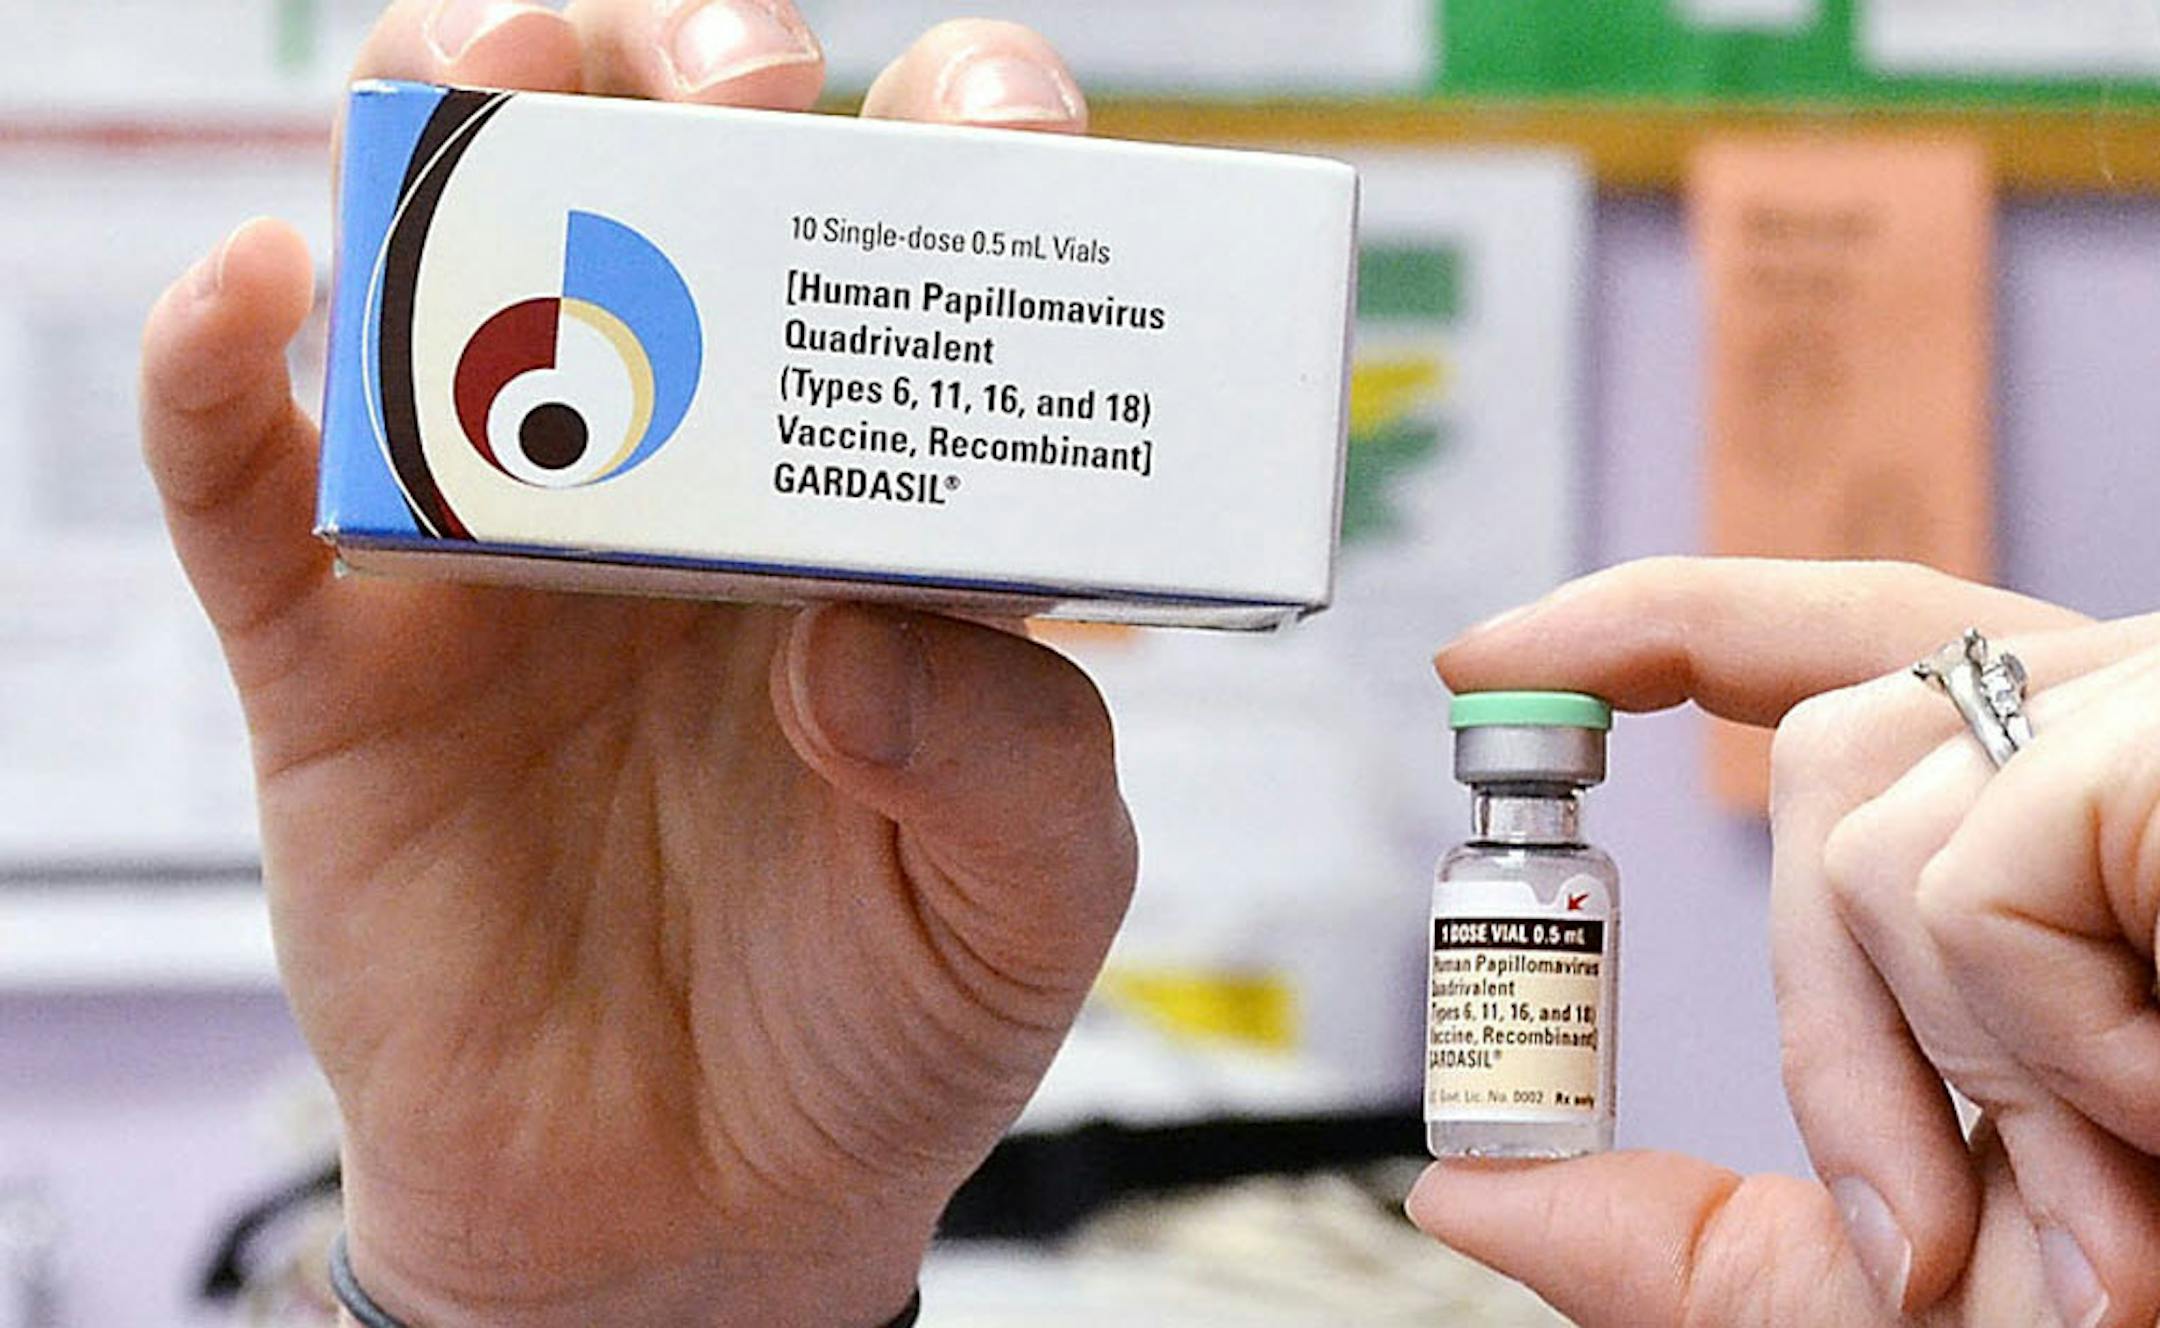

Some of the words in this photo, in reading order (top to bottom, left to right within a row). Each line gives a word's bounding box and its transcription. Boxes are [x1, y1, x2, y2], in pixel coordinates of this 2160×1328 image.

[793, 217, 817, 240] 10
[824, 218, 966, 253] Single-dose
[973, 231, 1006, 257] 0.5
[1012, 240, 1047, 261] mL
[1054, 237, 1110, 265] Vials
[786, 269, 910, 311] [Human
[922, 282, 1165, 330] Papillomavirus
[785, 319, 994, 365] Quadrivalent
[780, 365, 883, 409] (Types
[893, 376, 918, 411] 6,
[930, 379, 972, 415] 11,
[984, 384, 1025, 419] 16,
[1036, 394, 1095, 420] and
[1106, 393, 1151, 429] 18)
[777, 414, 917, 458] Vaccine,
[929, 425, 1153, 477] Recombinant]
[774, 462, 961, 505] GARDASIL®
[1442, 923, 1448, 943] 1
[1450, 923, 1487, 943] DOSE
[1491, 923, 1529, 943] VIAL
[1533, 923, 1561, 945] 0.5
[1476, 953, 1599, 978] Papillomavirus
[1482, 1002, 1505, 1023] 11,
[1511, 1003, 1534, 1023] 16,
[1539, 1003, 1571, 1022] and
